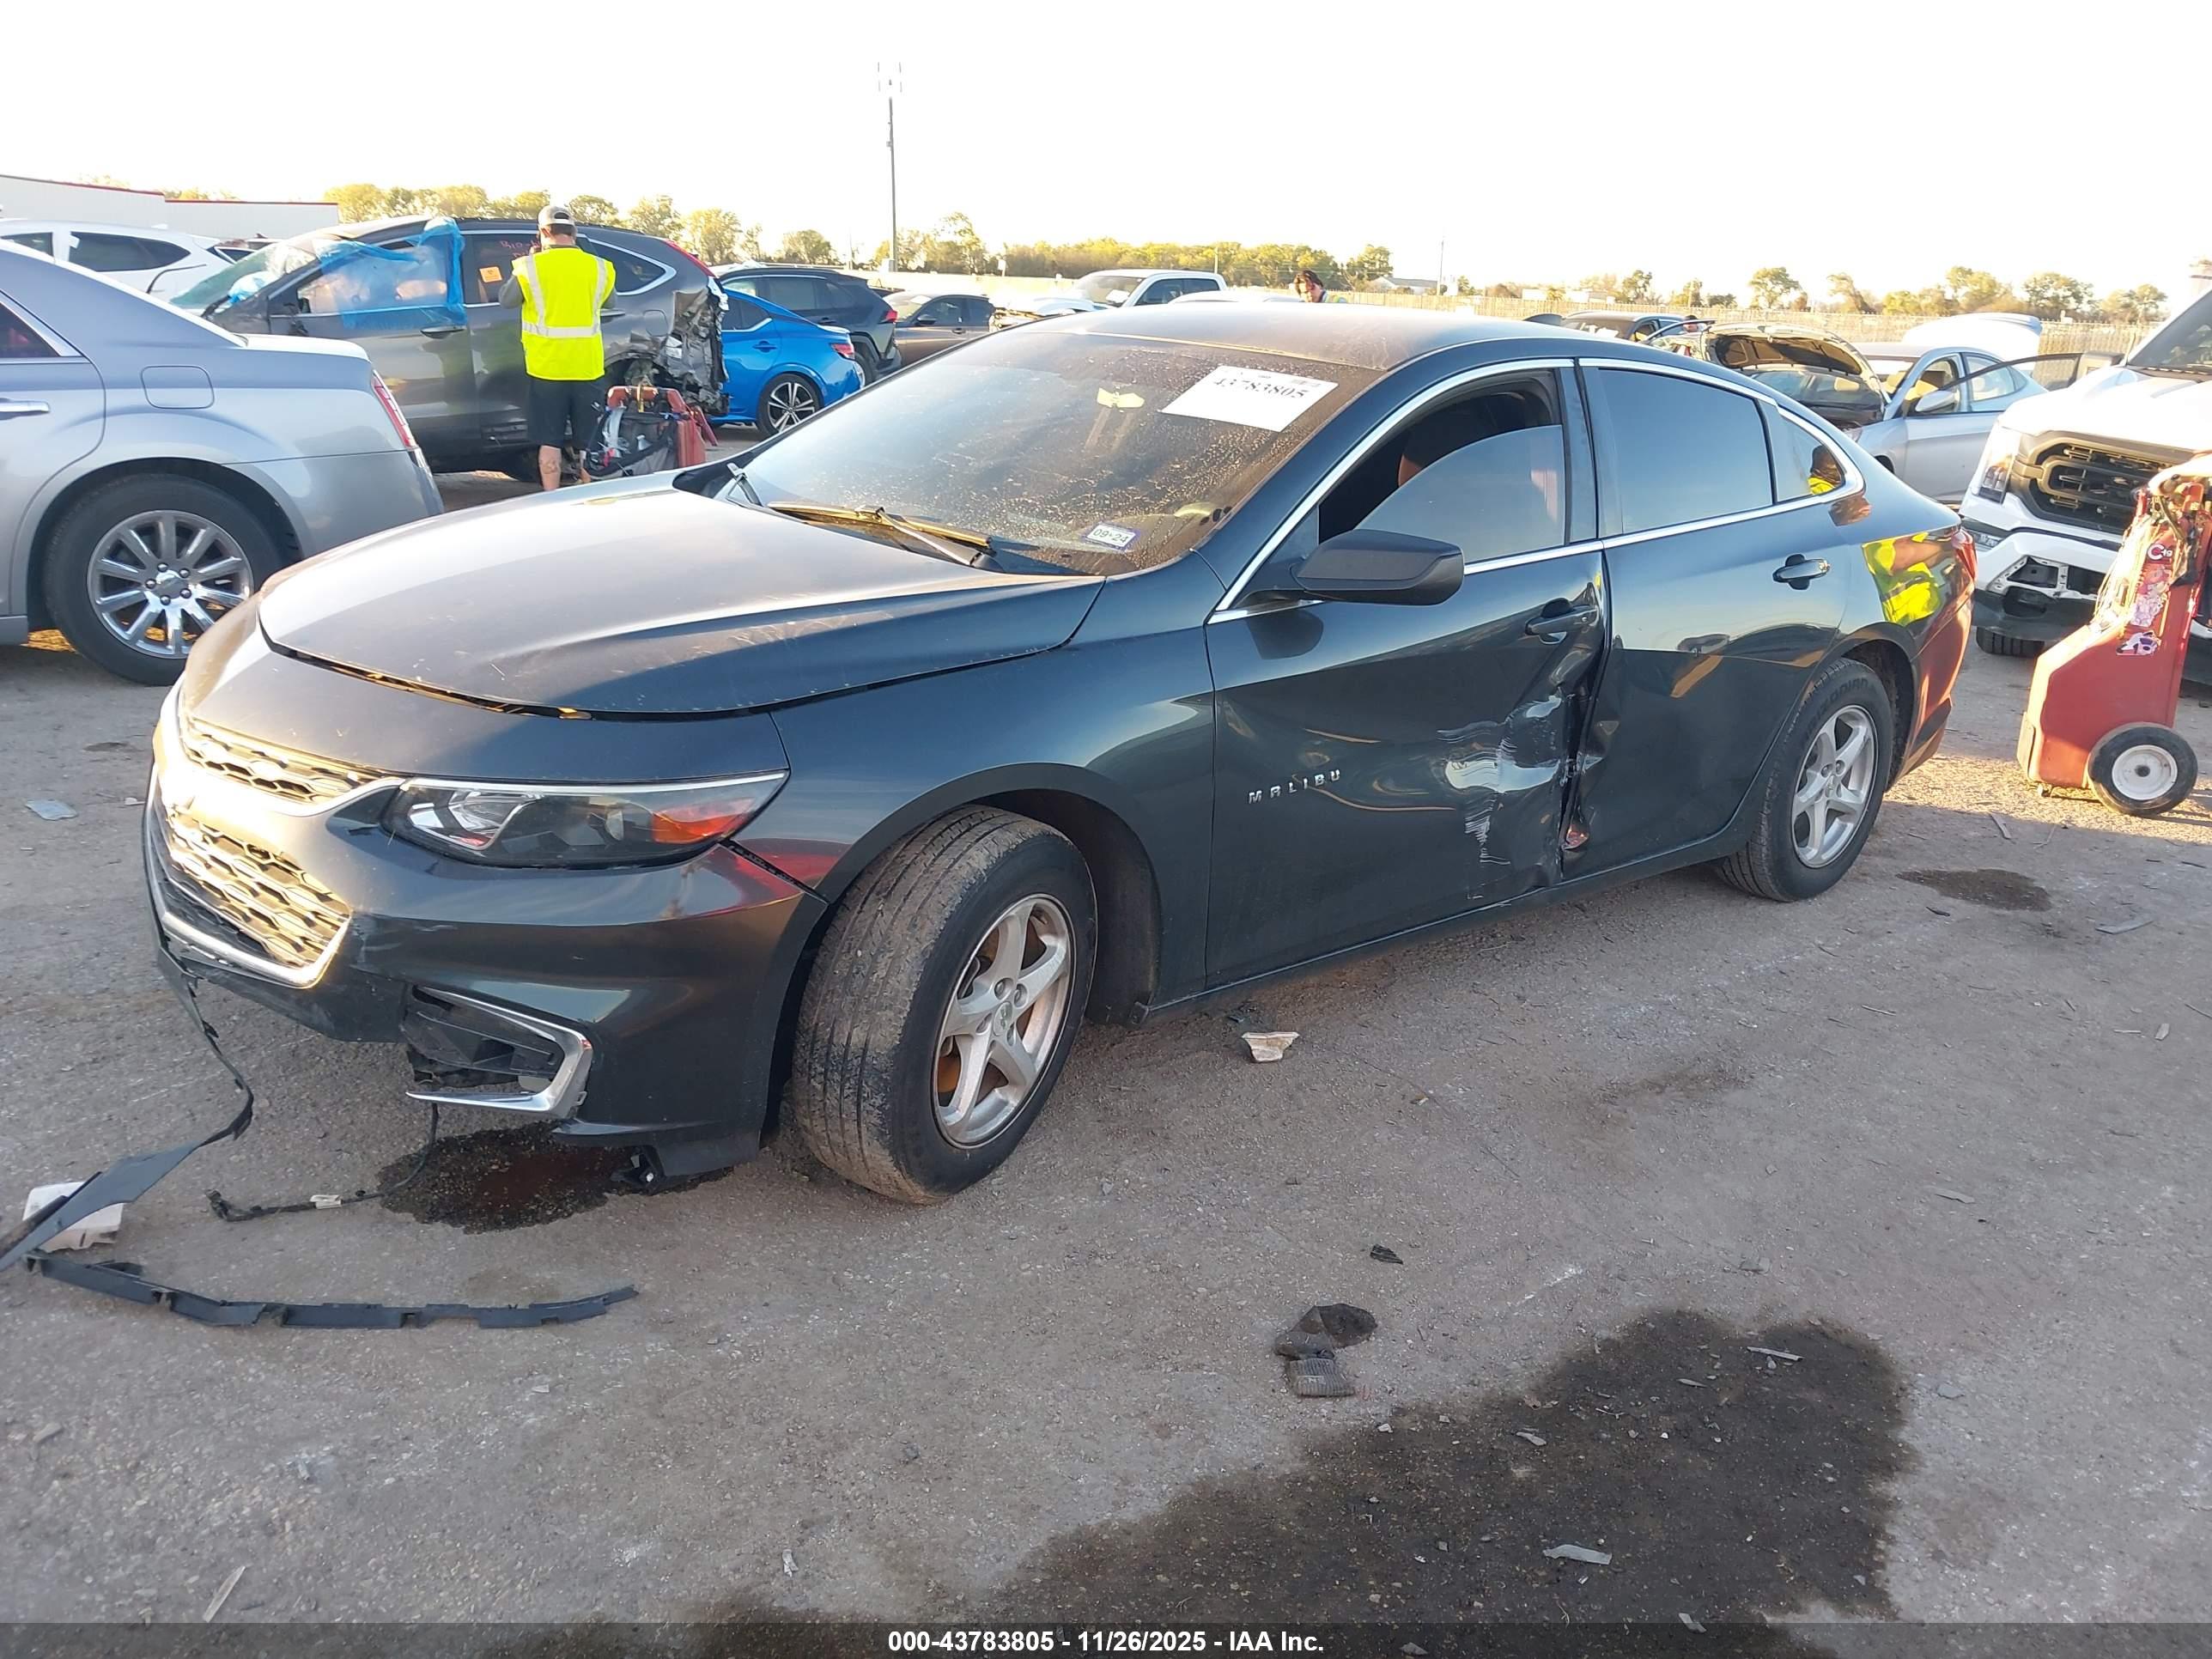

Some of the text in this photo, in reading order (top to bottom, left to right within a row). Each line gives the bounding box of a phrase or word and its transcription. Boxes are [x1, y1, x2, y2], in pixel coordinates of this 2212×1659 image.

[1093, 528, 1129, 544] 09 24
[1248, 769, 1340, 804] MALIBU
